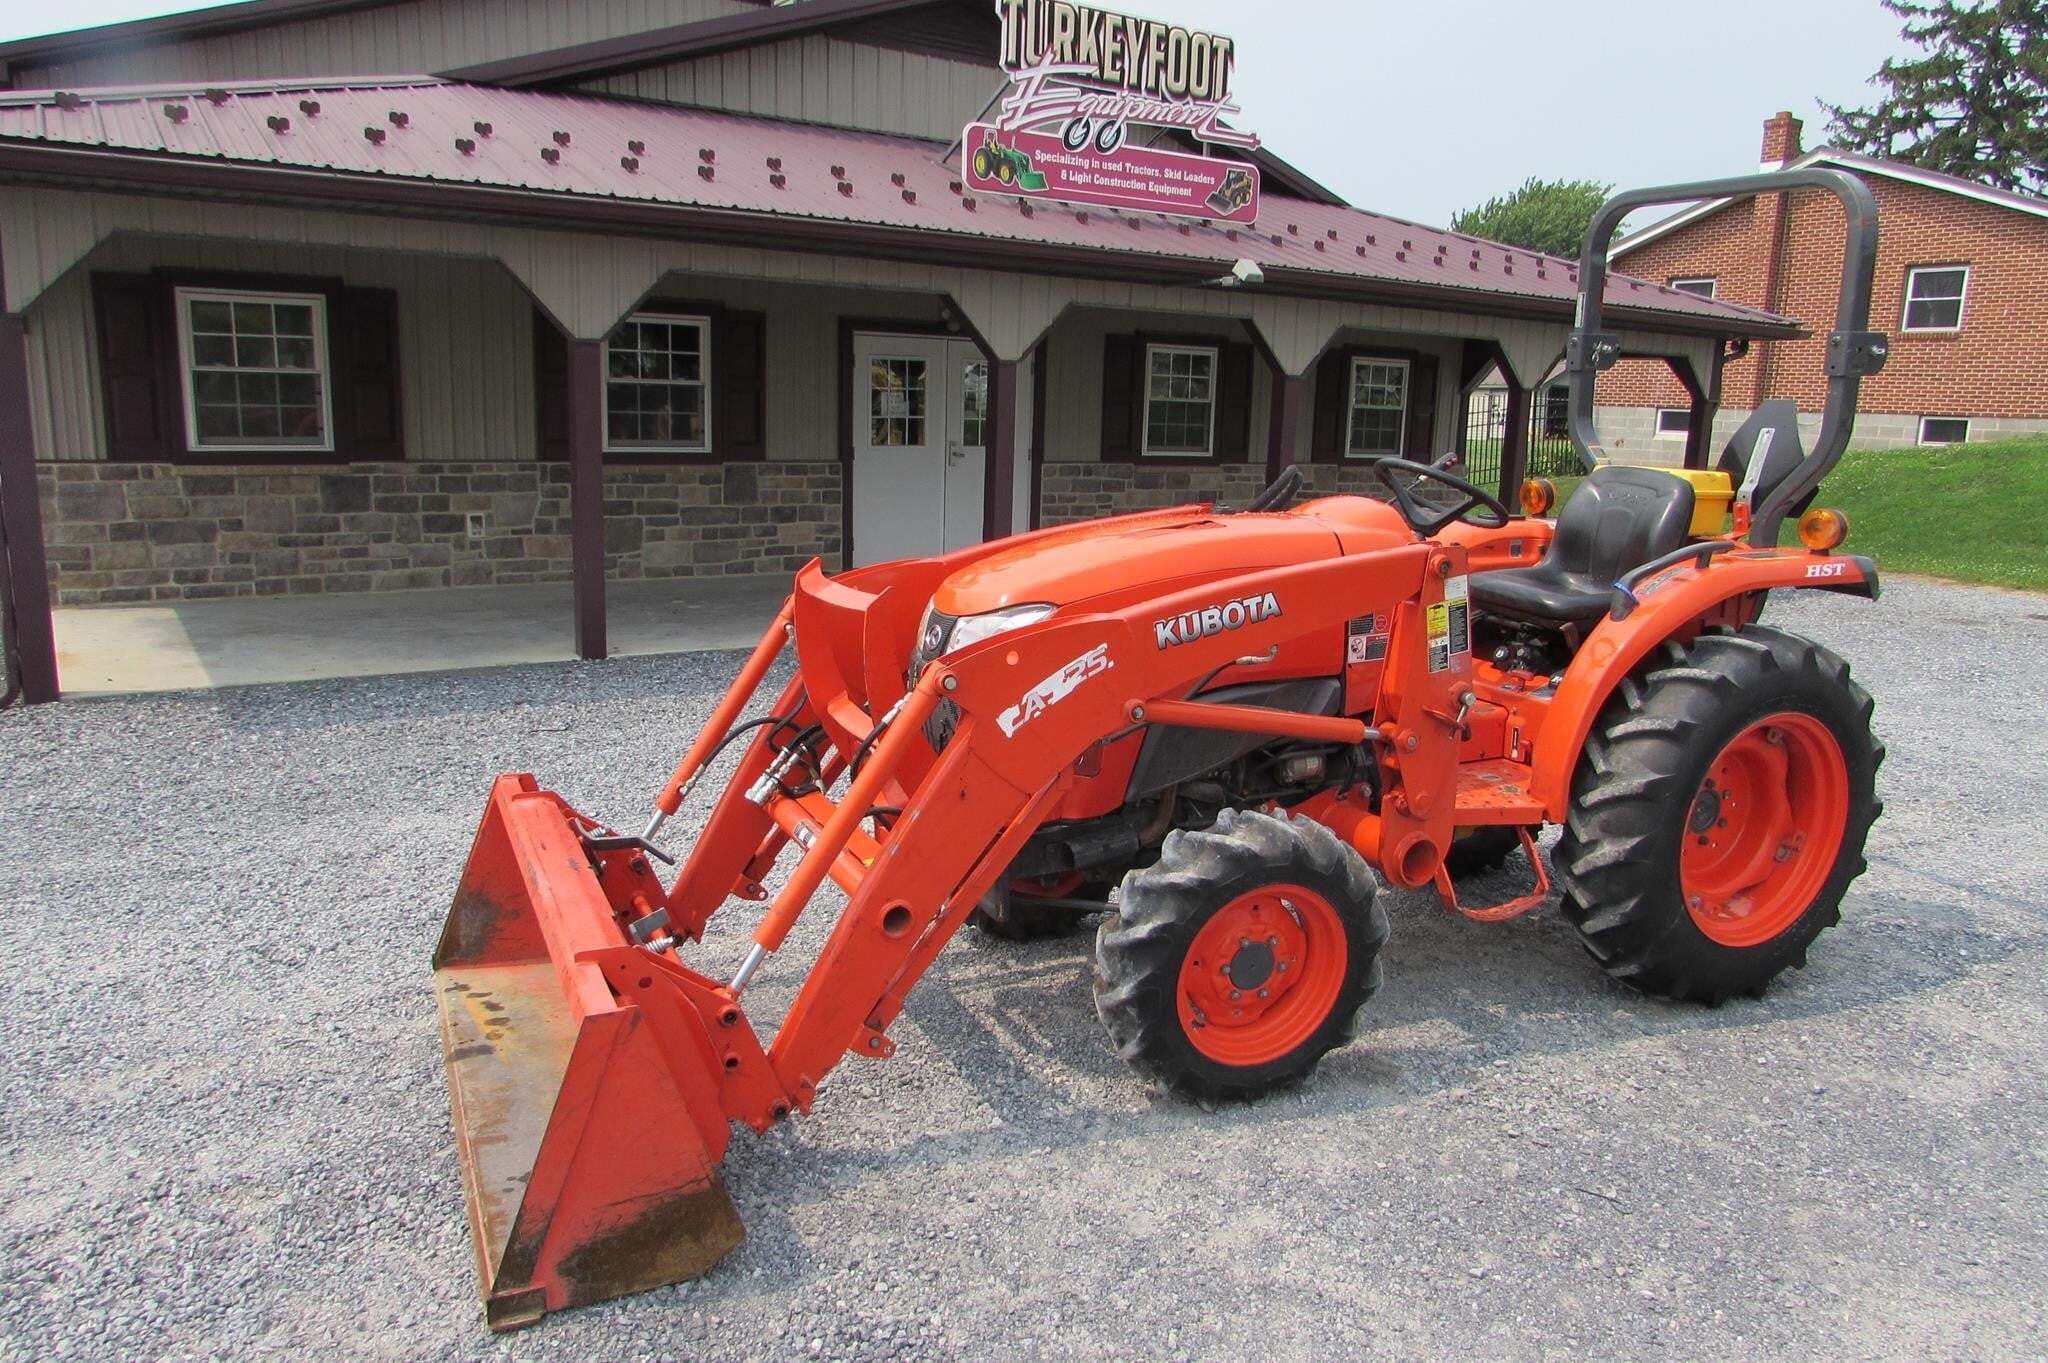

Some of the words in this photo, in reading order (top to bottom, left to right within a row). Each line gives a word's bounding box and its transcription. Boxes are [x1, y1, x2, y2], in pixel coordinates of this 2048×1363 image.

[1001, 0, 1234, 101] TURKEYFOOT
[1002, 48, 1258, 145] Equipment
[1034, 149, 1090, 170] Specializing
[1091, 157, 1100, 169] in
[1101, 161, 1123, 172] used
[1163, 168, 1182, 181] Skid
[1183, 171, 1215, 185] Loaders
[1060, 170, 1067, 180] &
[1069, 170, 1092, 186] Light
[1093, 174, 1146, 191] Construction
[1148, 182, 1192, 197] Equipment
[1804, 563, 1846, 578] HST
[1154, 592, 1283, 650] KUBOTA
